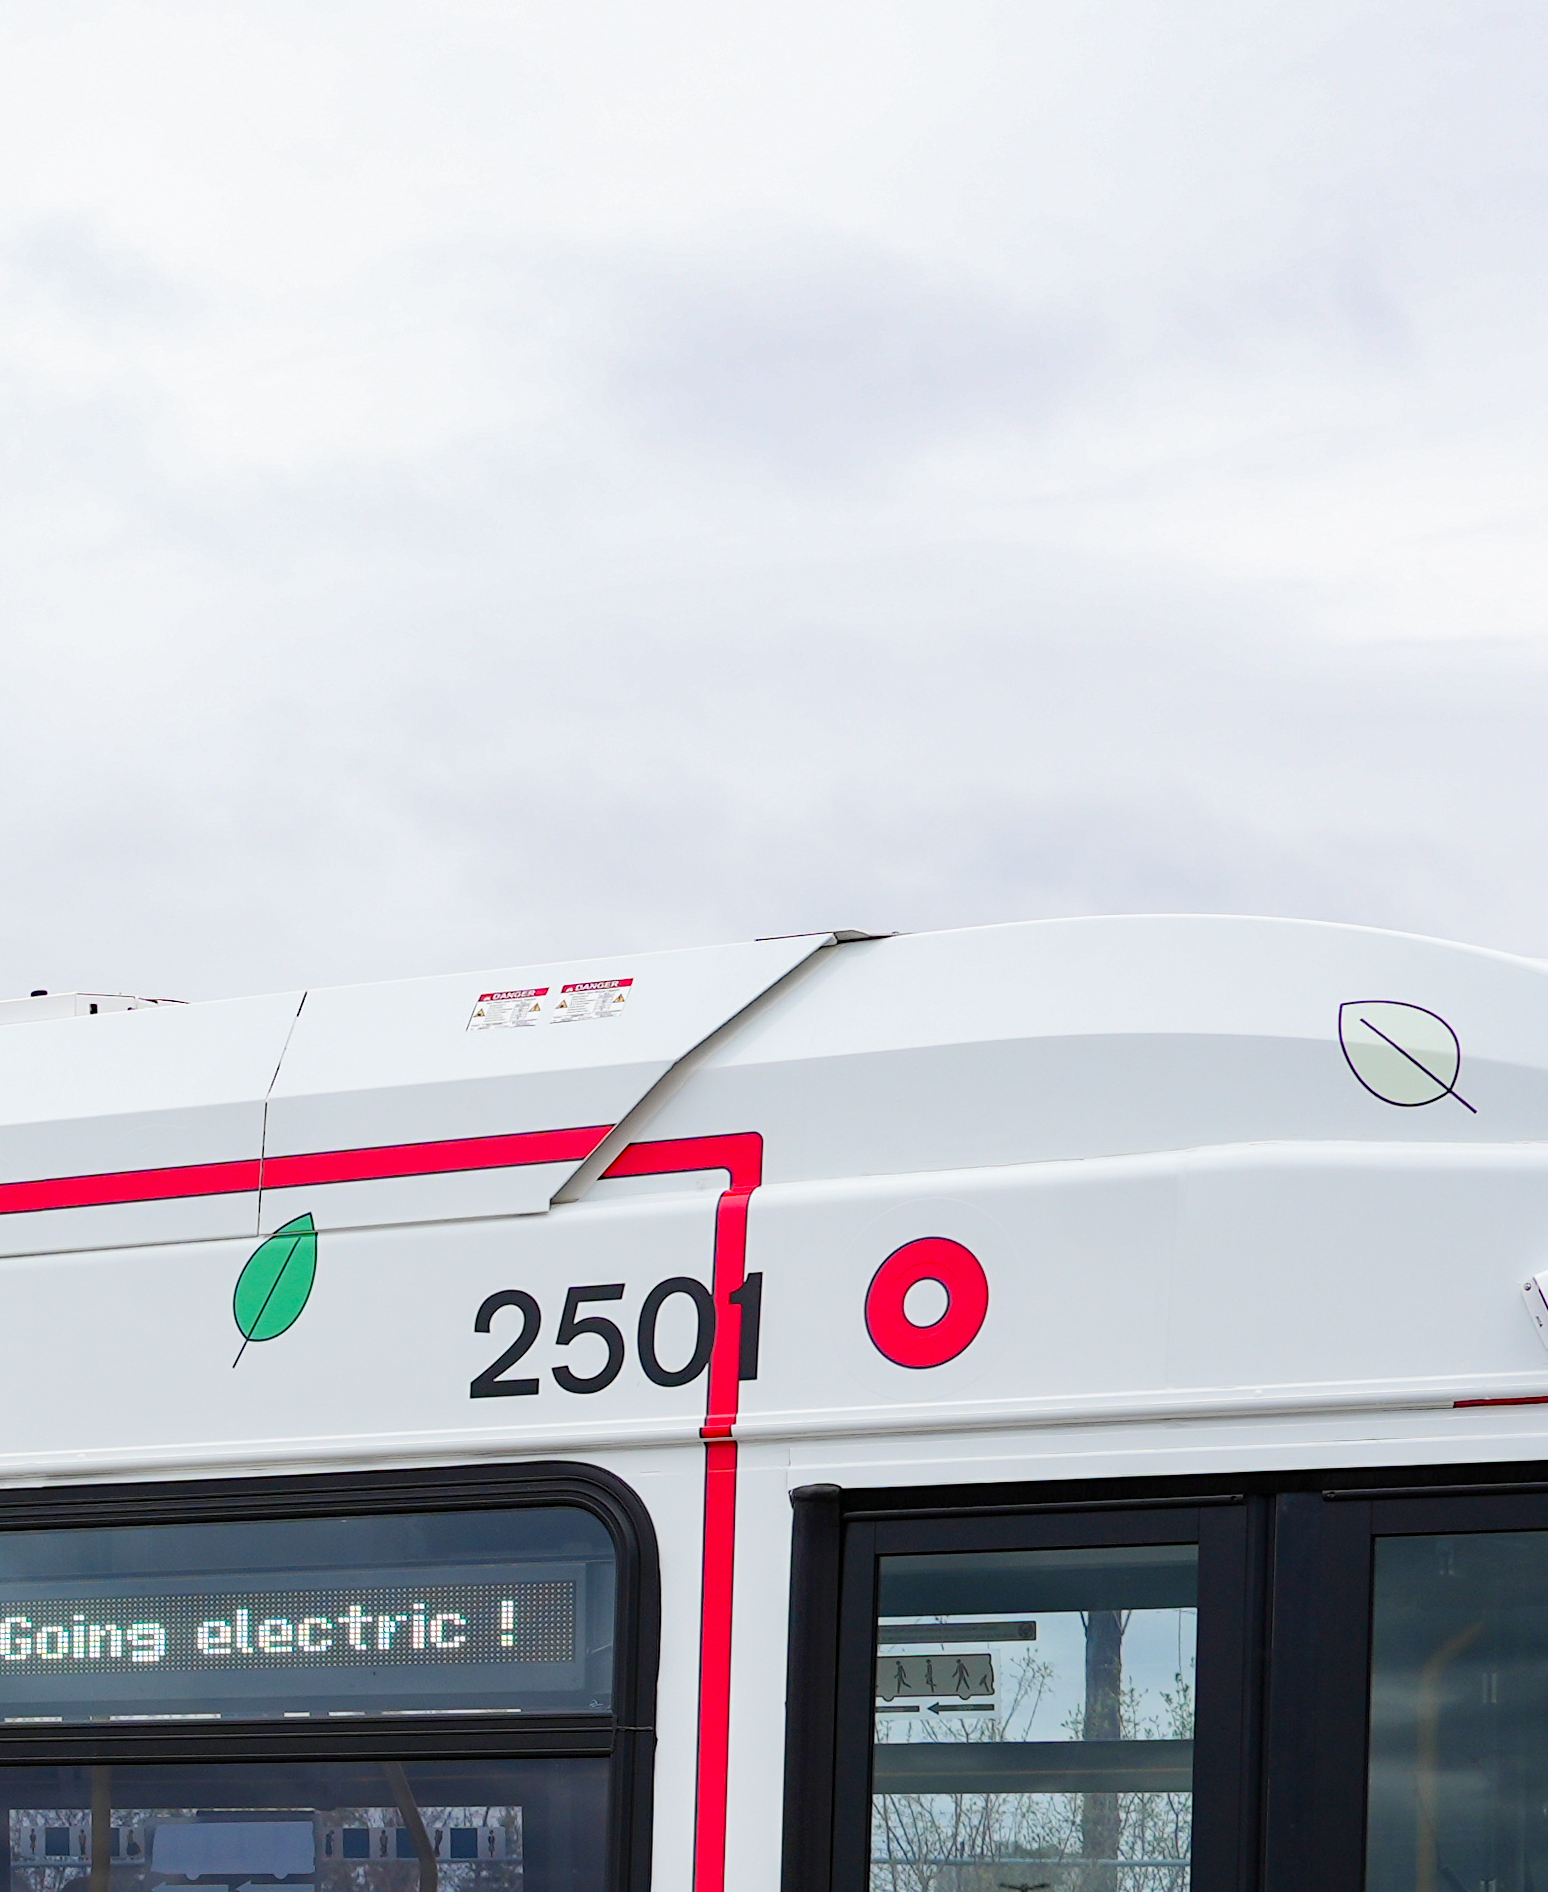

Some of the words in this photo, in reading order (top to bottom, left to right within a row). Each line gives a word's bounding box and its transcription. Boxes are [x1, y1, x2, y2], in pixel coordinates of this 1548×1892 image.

[492, 989, 536, 1000] DANGER
[575, 980, 620, 992] DANGER
[470, 1271, 764, 1399] 2501
[0, 1614, 167, 1664] Going
[196, 1602, 468, 1655] electric
